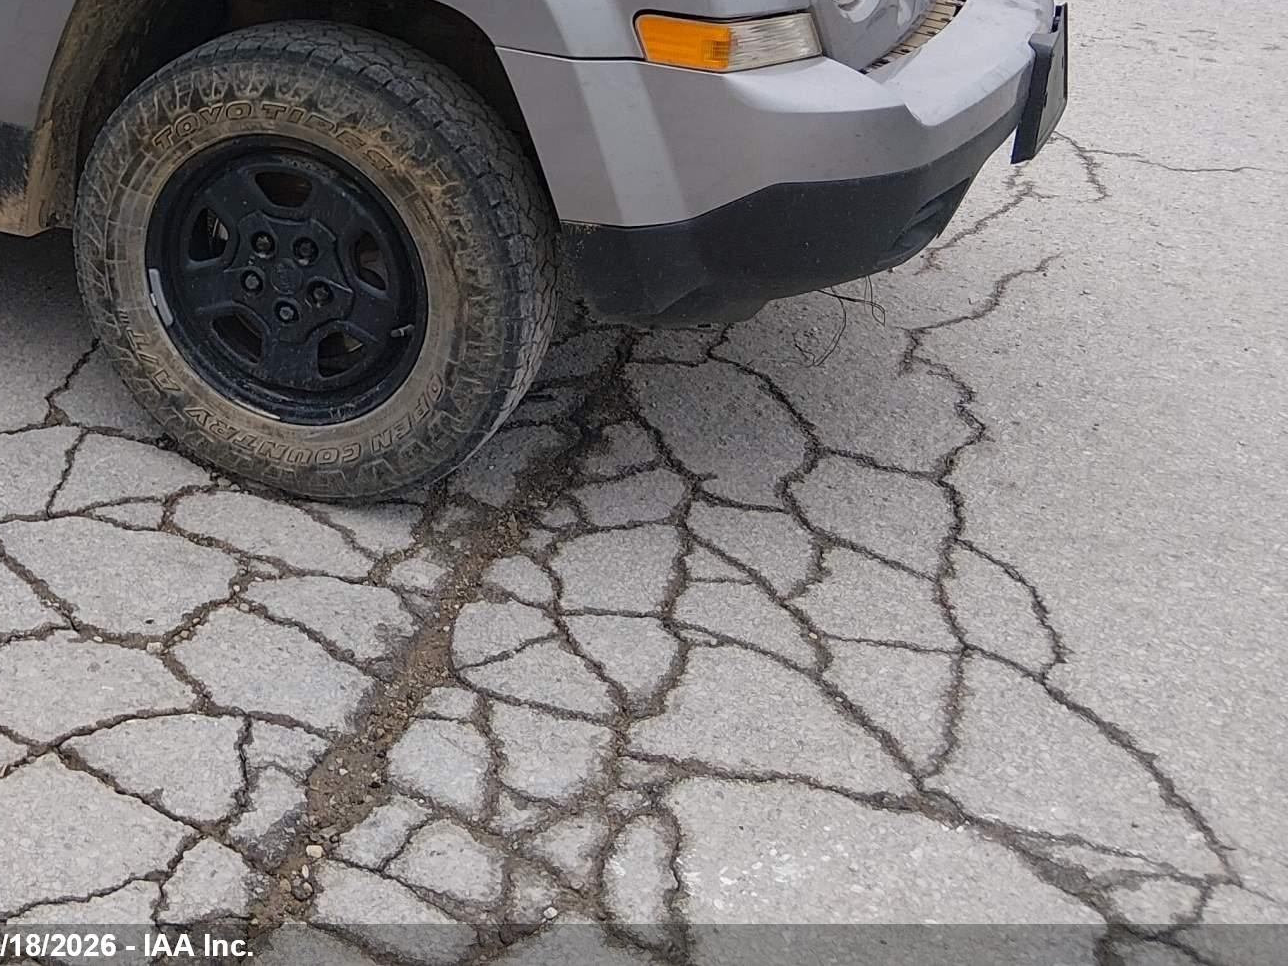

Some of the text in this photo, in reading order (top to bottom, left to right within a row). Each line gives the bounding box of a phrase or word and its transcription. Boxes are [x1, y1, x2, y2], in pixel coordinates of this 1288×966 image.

[151, 99, 397, 172] TOYO TIRES
[125, 326, 185, 393] A/T
[182, 405, 363, 468] COUNTRY
[368, 374, 446, 454] OPEN
